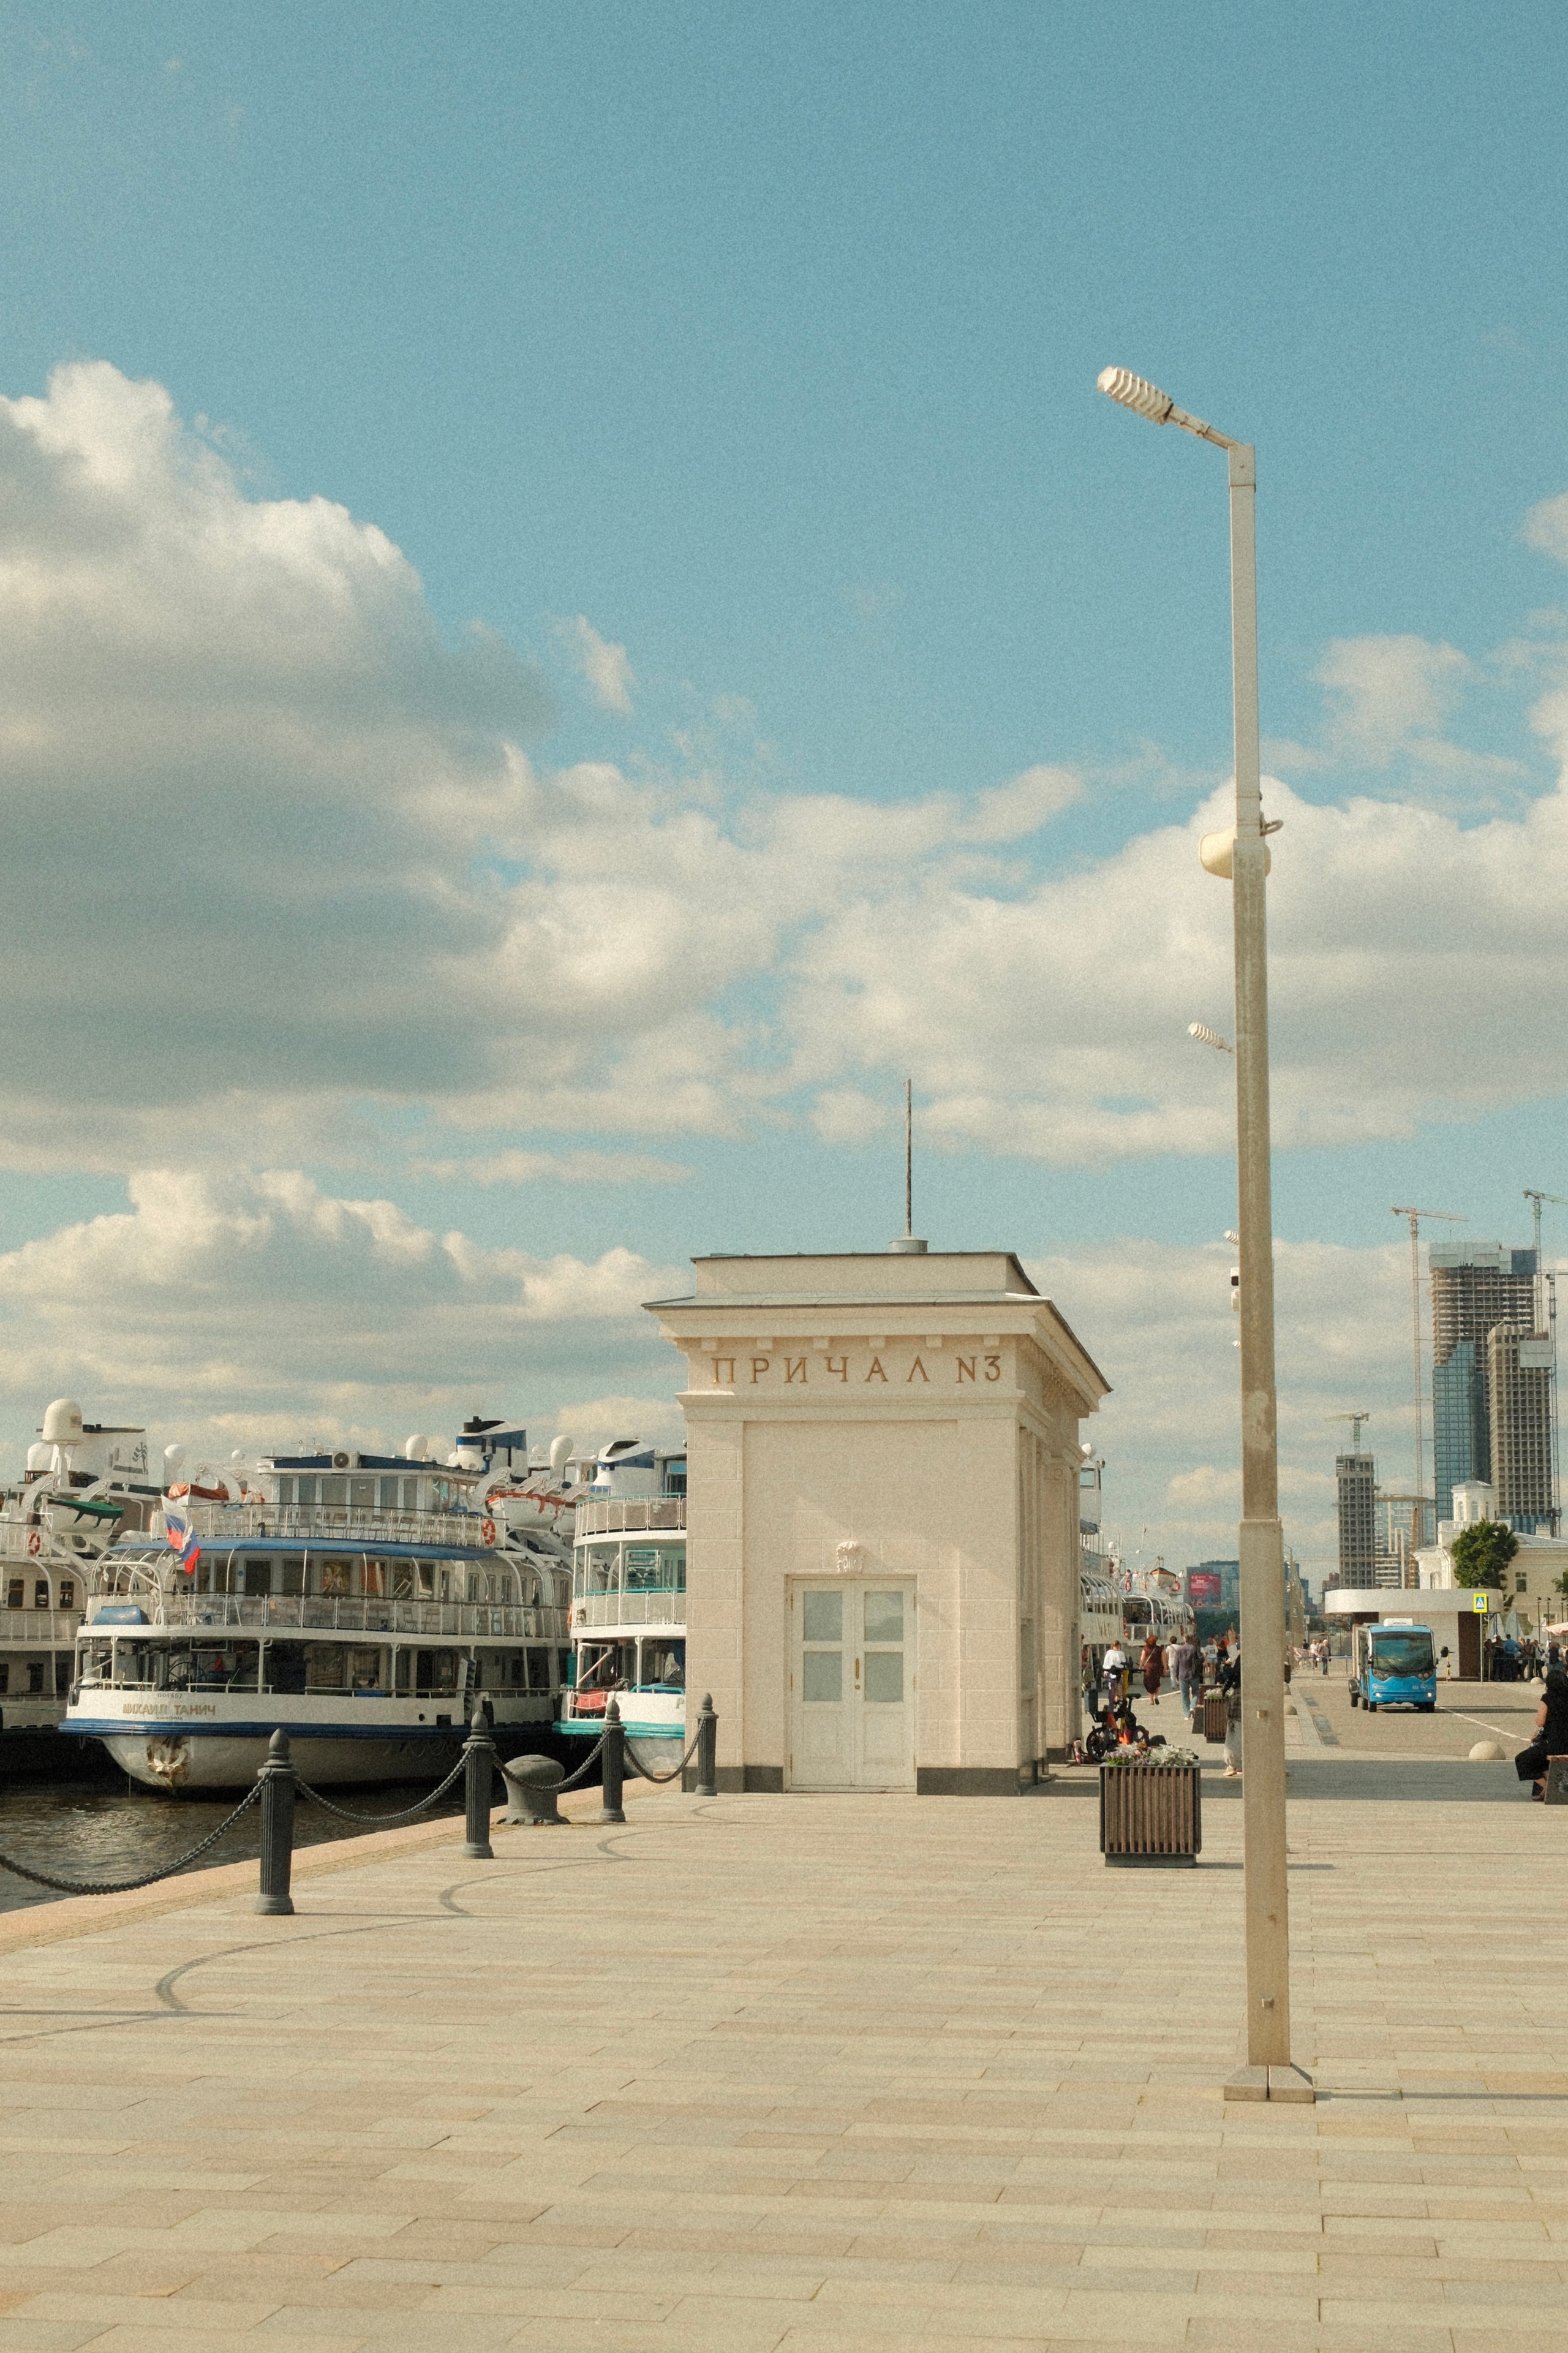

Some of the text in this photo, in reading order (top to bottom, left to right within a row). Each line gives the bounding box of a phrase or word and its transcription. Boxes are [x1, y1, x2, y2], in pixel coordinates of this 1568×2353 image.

[710, 1356, 930, 1383] ПРИЧАЛ
[123, 1703, 216, 1716] МИХАИЛ ТАНИЧ
